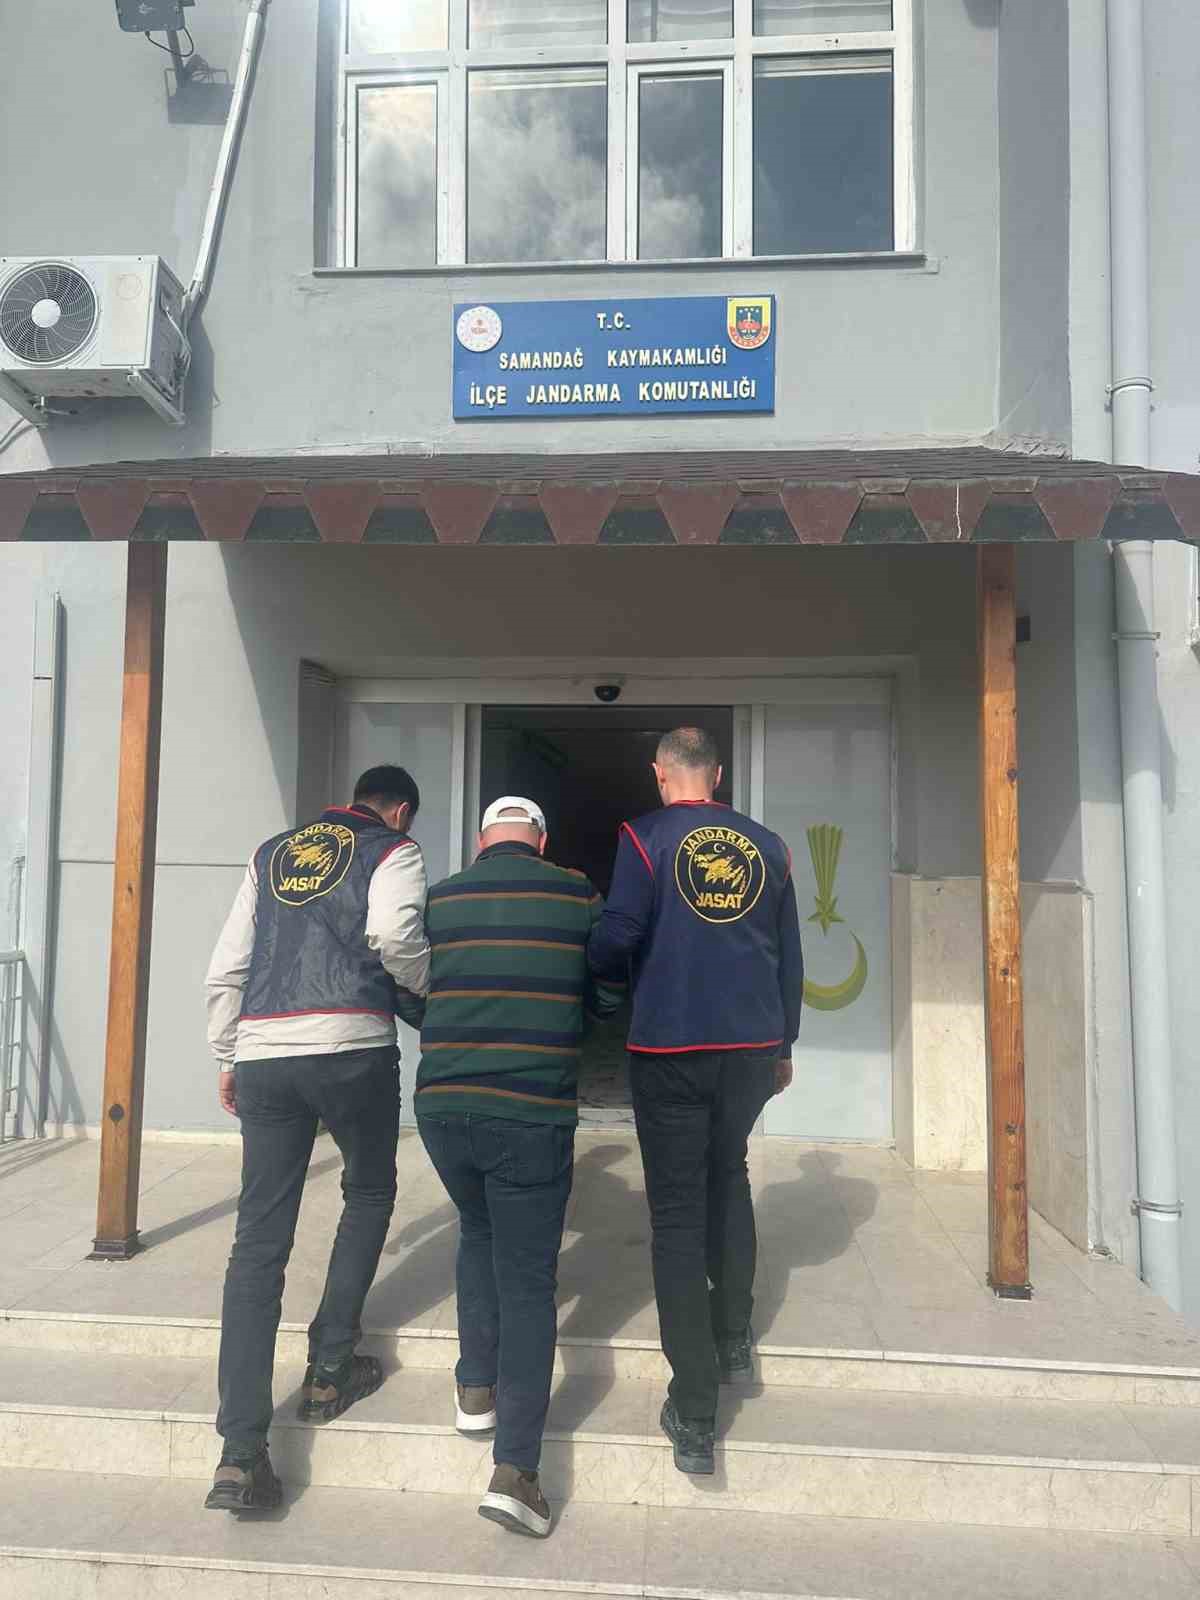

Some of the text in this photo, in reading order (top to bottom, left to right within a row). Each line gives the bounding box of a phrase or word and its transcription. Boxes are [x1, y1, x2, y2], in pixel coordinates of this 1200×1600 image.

[597, 312, 631, 329] T.C.
[499, 345, 727, 370] SAMANDAĞ KAYMAKAMLIĞI
[470, 376, 756, 408] İLÇE JANDARMA KOMUTANLIĞI
[683, 829, 757, 860] JANDARMA
[279, 876, 324, 891] JASAT
[696, 893, 744, 909] JASAT
